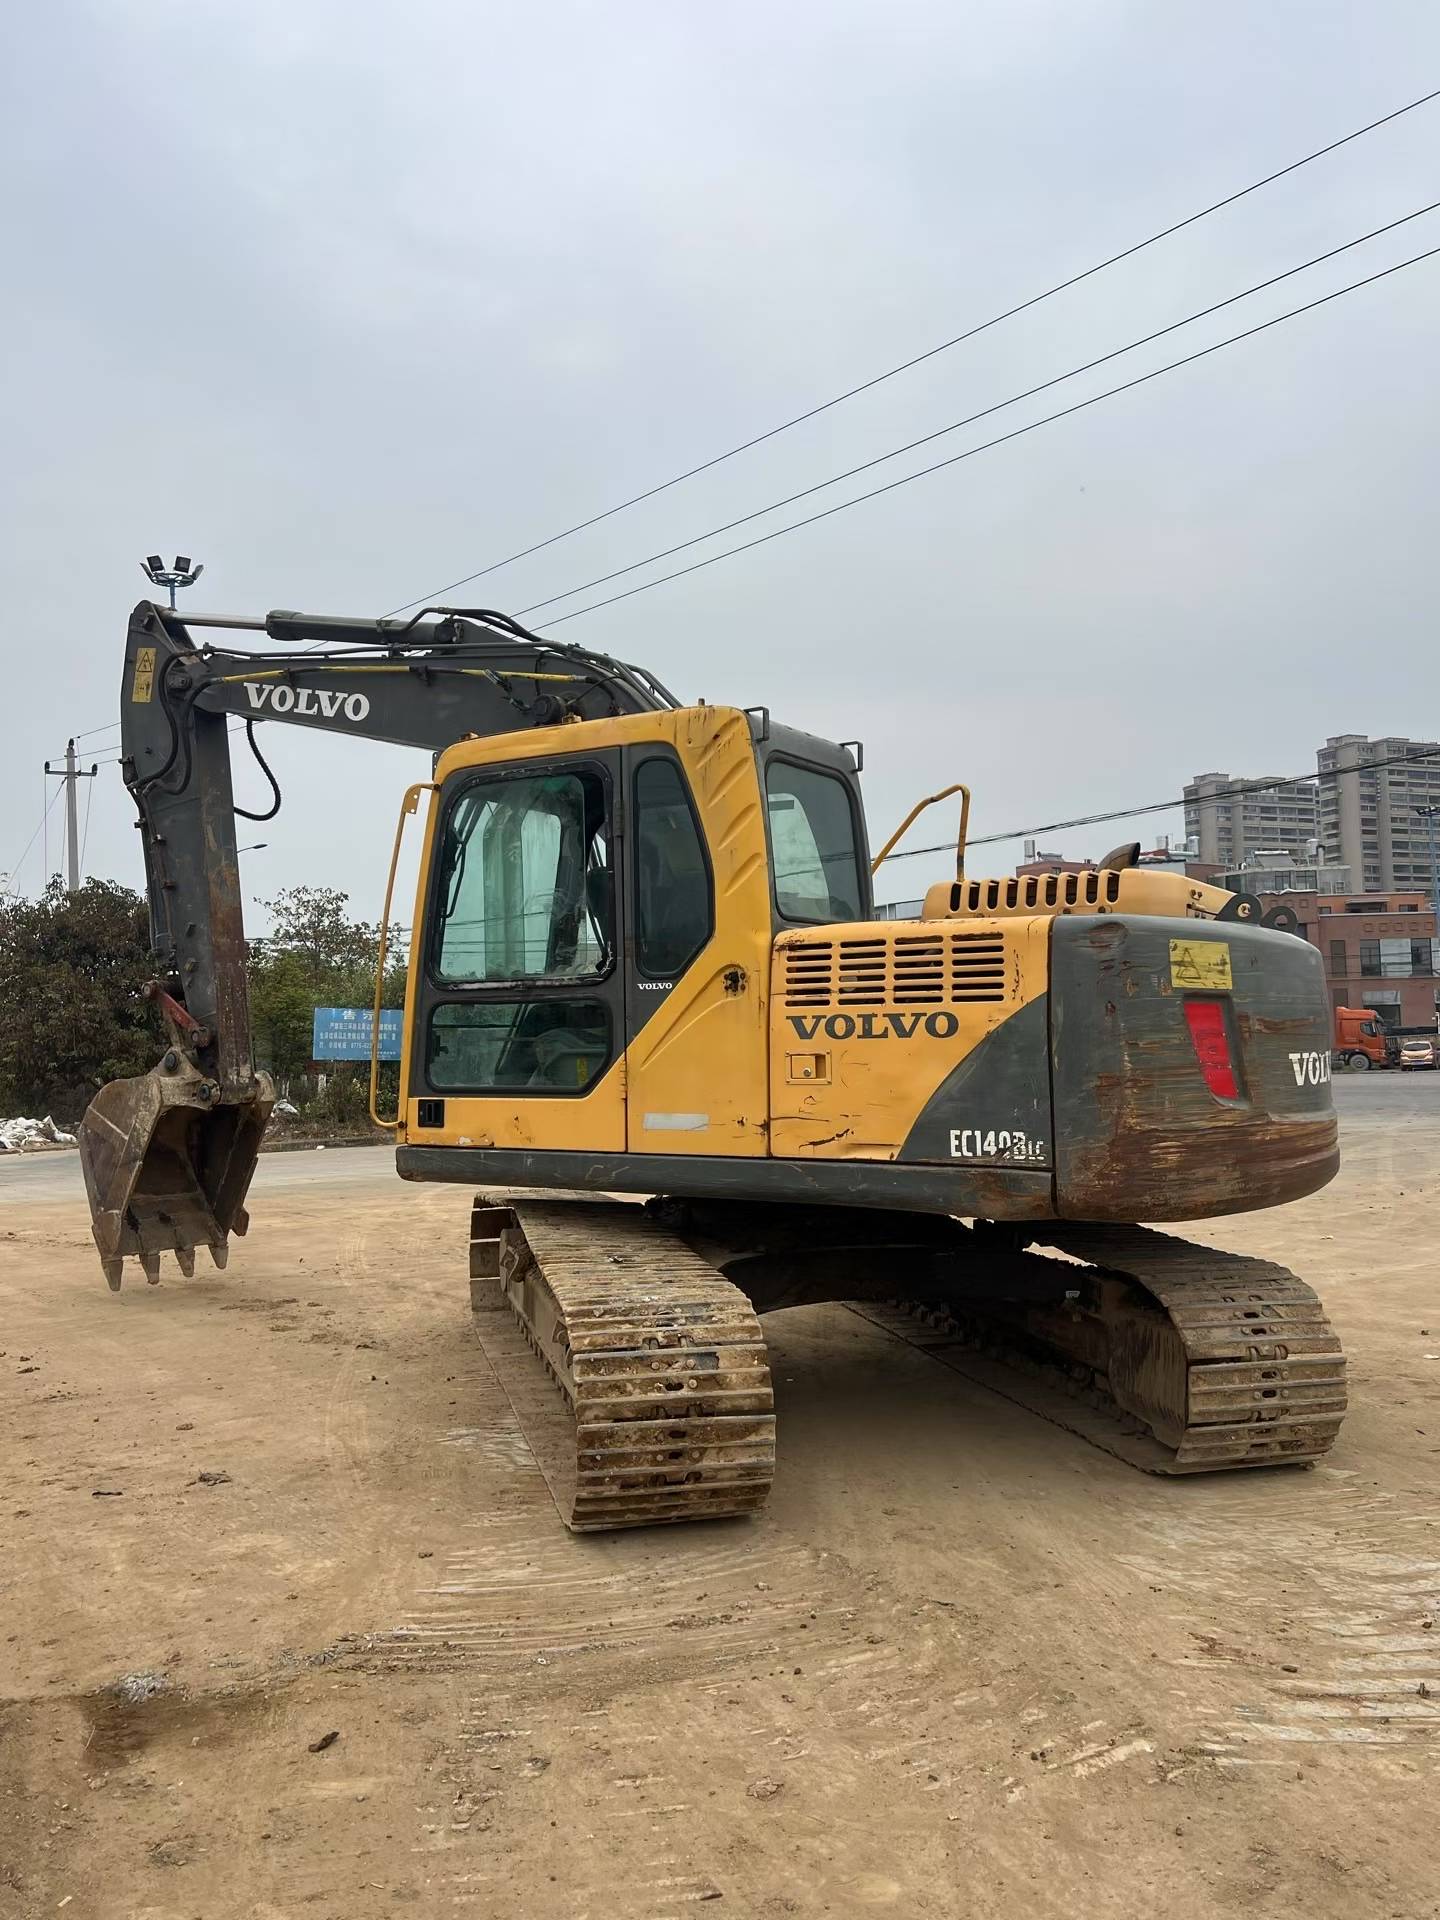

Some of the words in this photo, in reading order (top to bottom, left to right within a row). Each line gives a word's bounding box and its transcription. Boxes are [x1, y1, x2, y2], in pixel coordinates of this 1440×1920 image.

[243, 682, 370, 722] VOLVO
[637, 982, 673, 990] VOLVO
[786, 1011, 959, 1040] VOLVO
